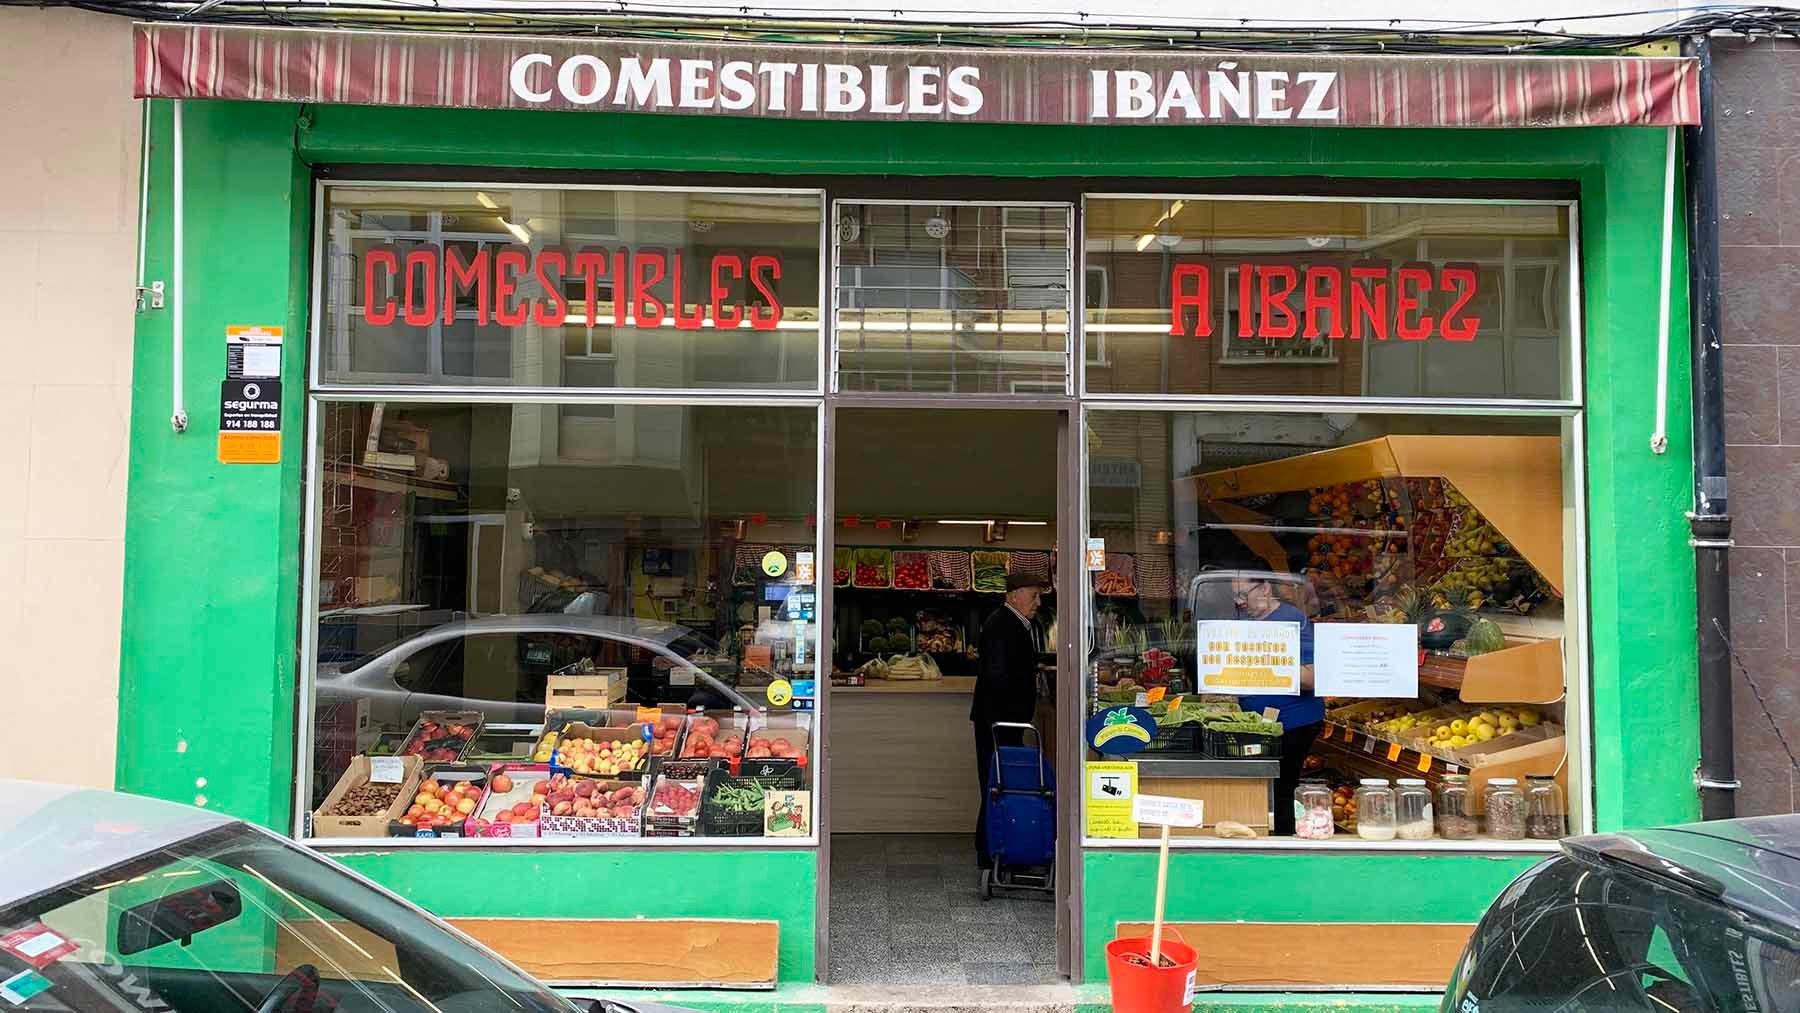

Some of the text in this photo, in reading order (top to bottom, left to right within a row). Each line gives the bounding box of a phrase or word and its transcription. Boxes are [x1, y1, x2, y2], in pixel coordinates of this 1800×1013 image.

[509, 51, 1340, 121] COMESTIBLES IBAÑEZ
[363, 251, 782, 331] COMESTIBLES
[1170, 264, 1480, 342] A IBAÑEZ
[224, 400, 278, 411] segurma
[226, 420, 241, 428] 914
[243, 420, 258, 428] 188
